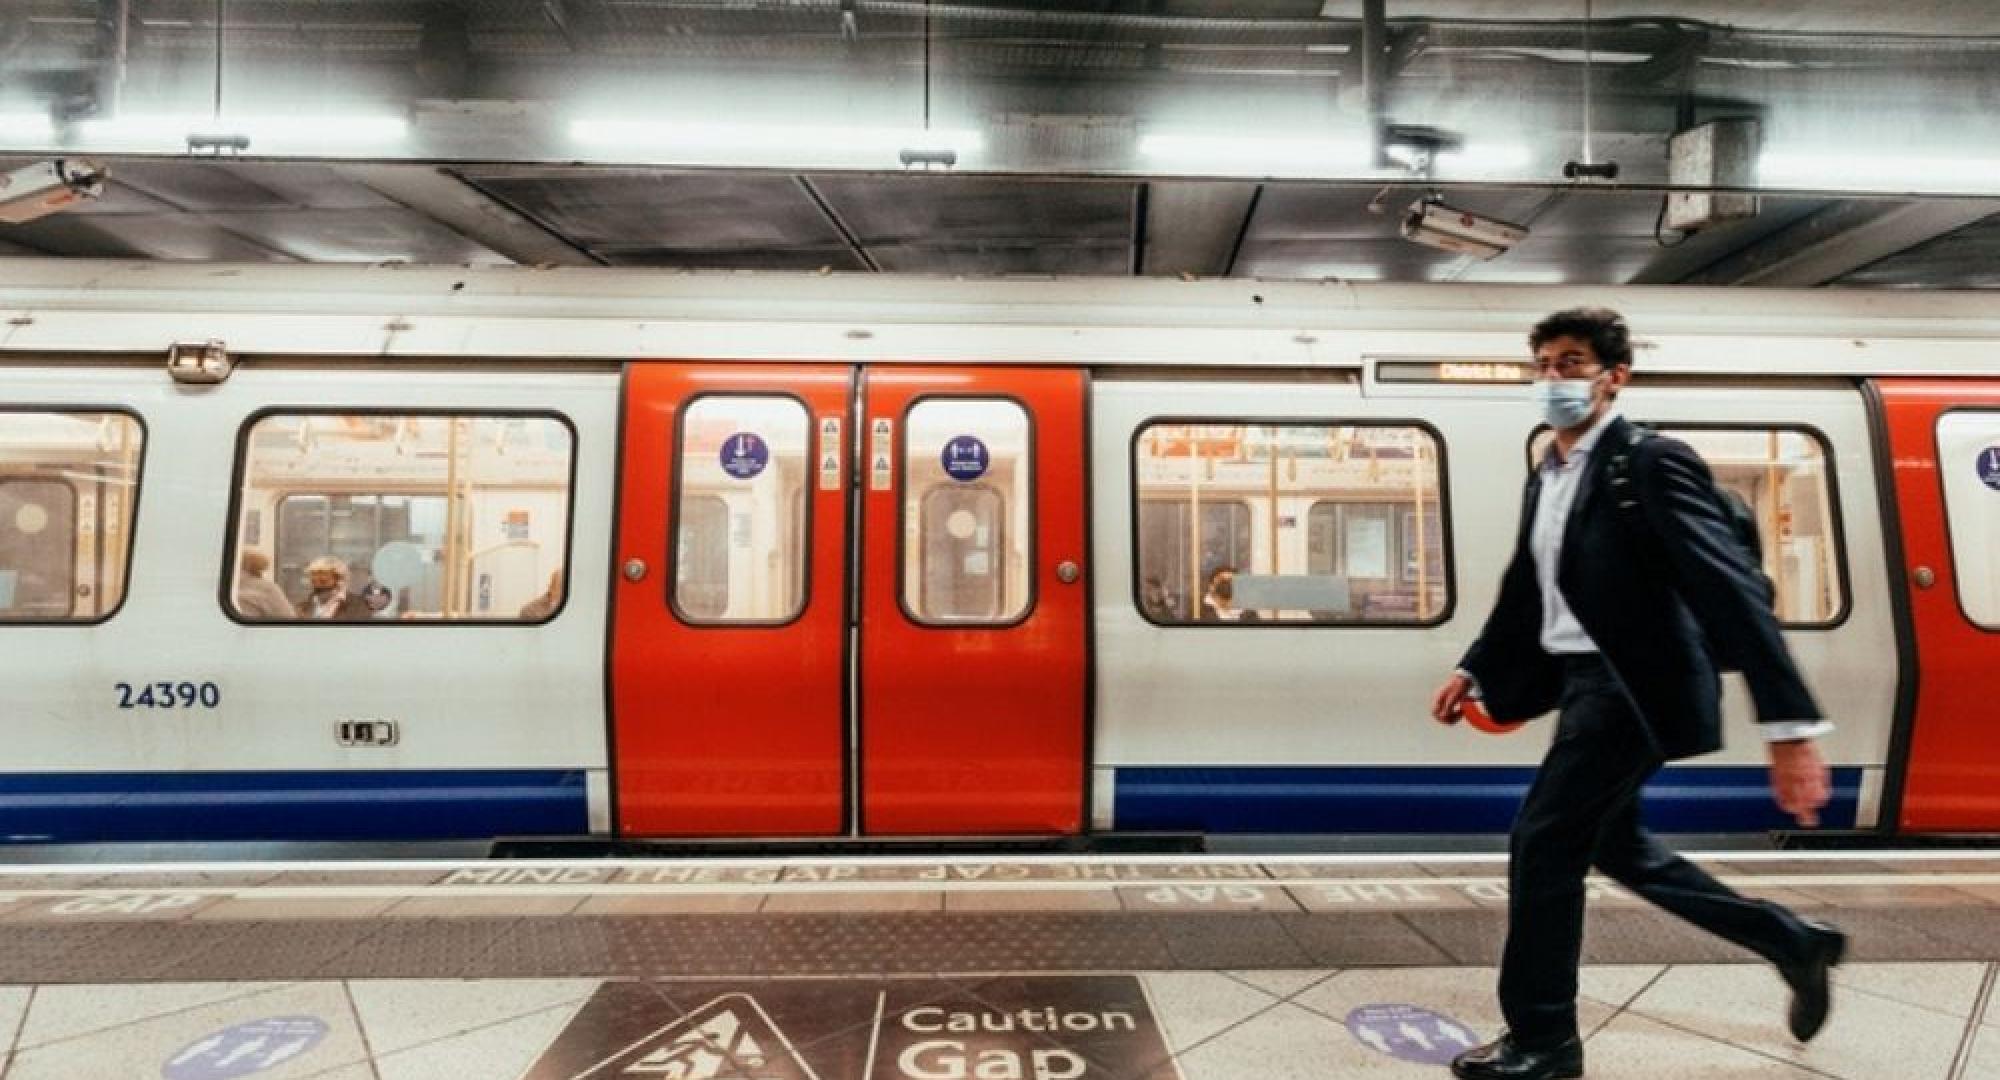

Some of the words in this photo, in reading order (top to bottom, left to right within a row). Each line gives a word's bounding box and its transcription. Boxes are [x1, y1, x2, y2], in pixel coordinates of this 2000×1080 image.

[114, 681, 221, 709] 24390
[446, 867, 602, 885] MIND
[616, 867, 718, 885] THE
[741, 866, 860, 883] GAP
[1144, 884, 1265, 903] GAP
[1326, 884, 1442, 902] THE
[901, 1006, 1136, 1031] Caution
[897, 1039, 1087, 1080] Gap
